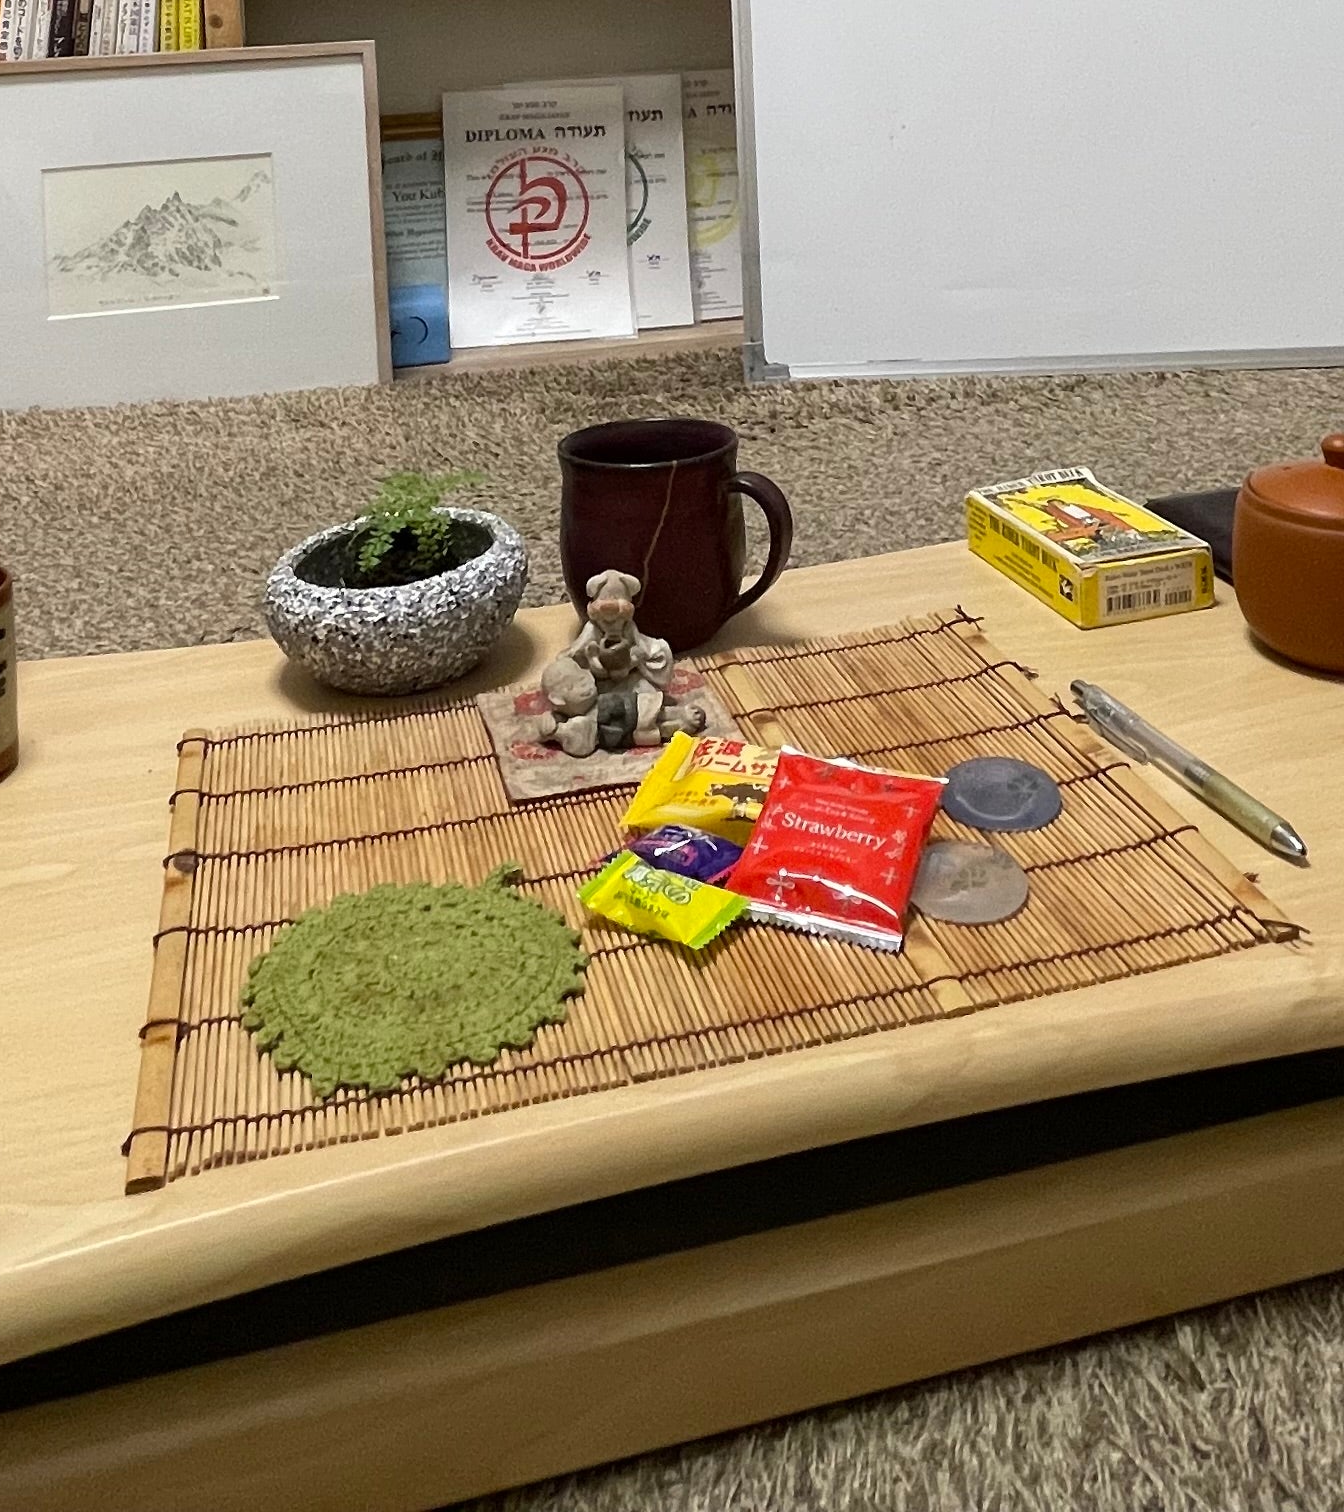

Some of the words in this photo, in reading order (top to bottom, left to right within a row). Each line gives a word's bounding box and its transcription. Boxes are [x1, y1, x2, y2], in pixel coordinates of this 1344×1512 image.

[465, 127, 546, 143] DIPLOMA
[554, 124, 607, 139] תעודה
[781, 811, 887, 852] Strawberry
